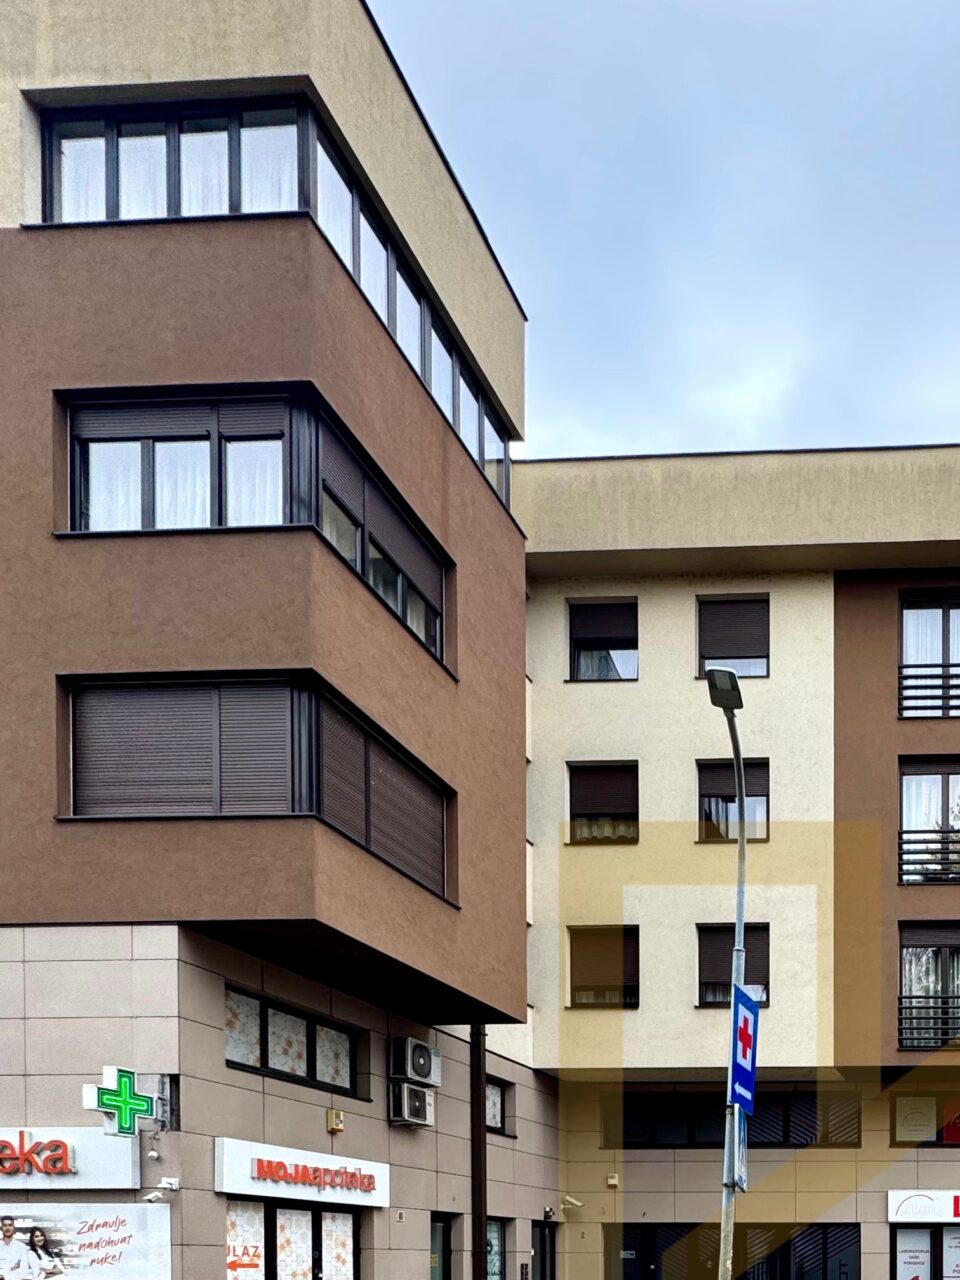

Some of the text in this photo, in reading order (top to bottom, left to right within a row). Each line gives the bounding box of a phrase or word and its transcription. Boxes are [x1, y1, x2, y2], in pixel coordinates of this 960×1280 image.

[254, 1158, 376, 1191] MOJAapoteka
[77, 1215, 128, 1235] Zdravlje
[78, 1234, 134, 1252] nadohvat
[90, 1252, 122, 1267] ruke!
